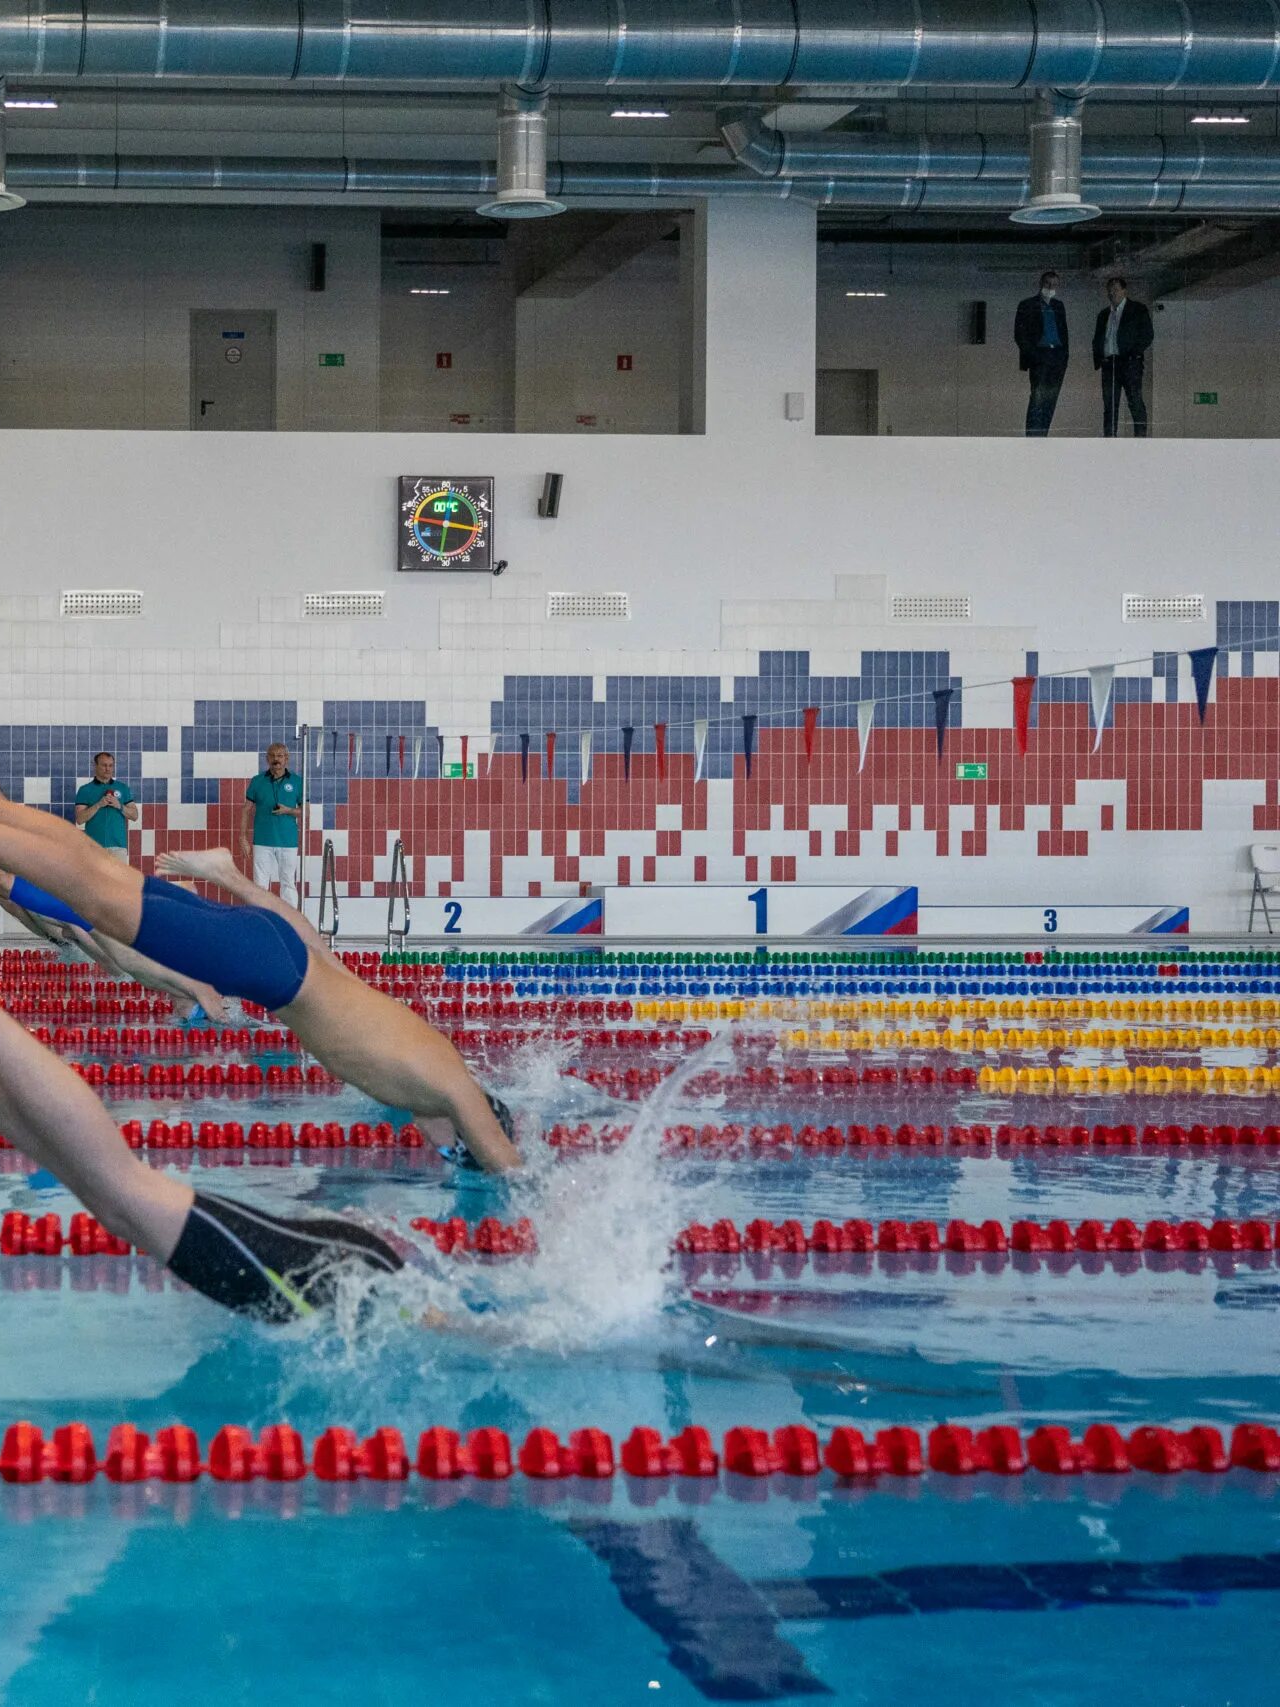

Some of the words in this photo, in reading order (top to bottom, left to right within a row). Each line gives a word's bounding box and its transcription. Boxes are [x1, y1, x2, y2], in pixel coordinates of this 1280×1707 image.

[444, 902, 462, 933] 2
[747, 888, 767, 934] 1
[1044, 909, 1057, 932] 3
